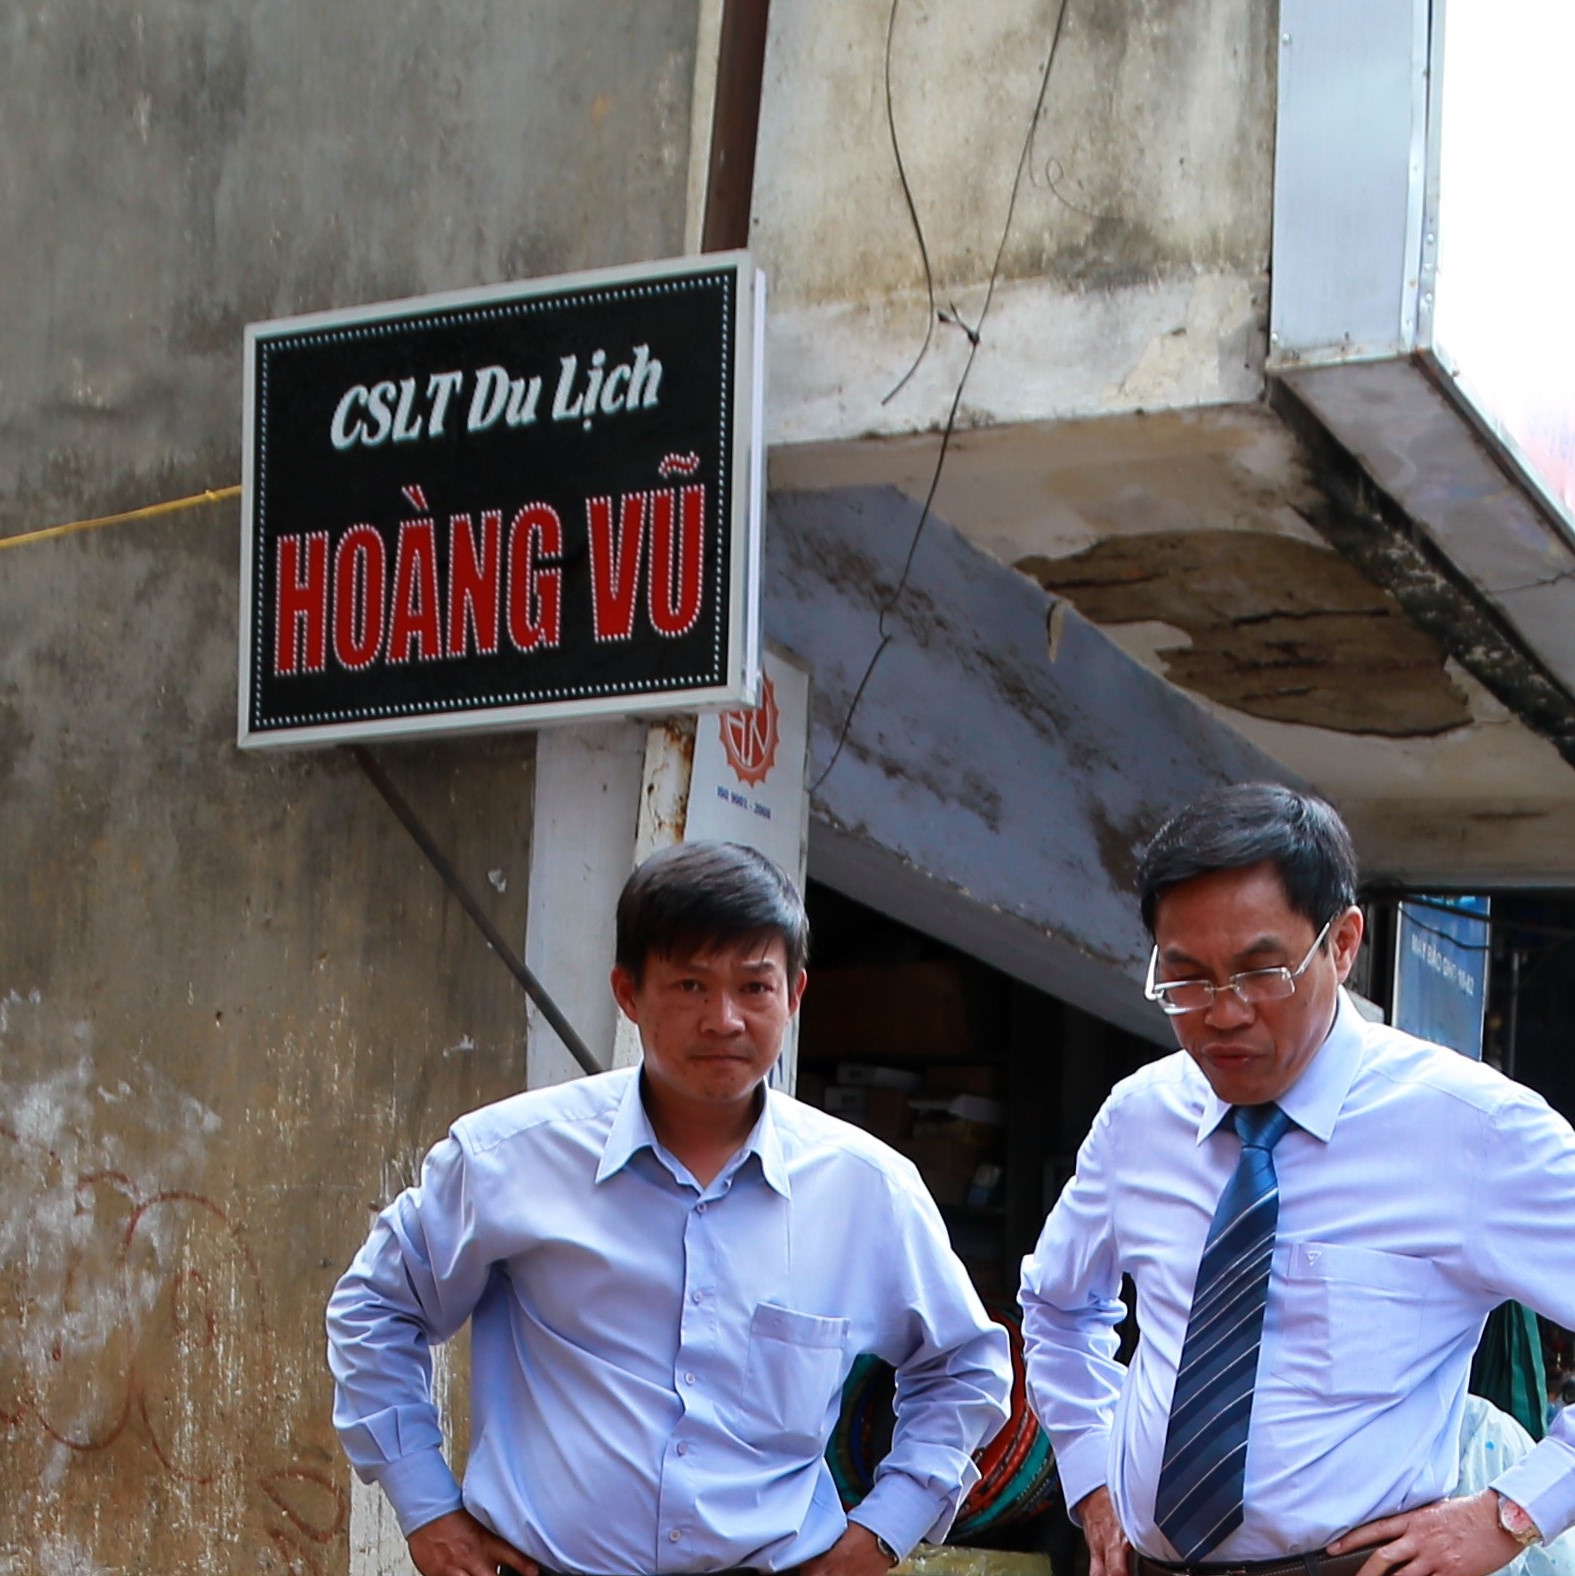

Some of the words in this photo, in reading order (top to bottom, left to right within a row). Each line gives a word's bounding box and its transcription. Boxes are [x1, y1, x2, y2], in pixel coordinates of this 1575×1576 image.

[331, 369, 462, 449] CSLT
[467, 362, 542, 433] Du
[553, 343, 662, 430] Lịch
[274, 485, 562, 676] HOÀNG
[585, 452, 706, 642] VŨ
